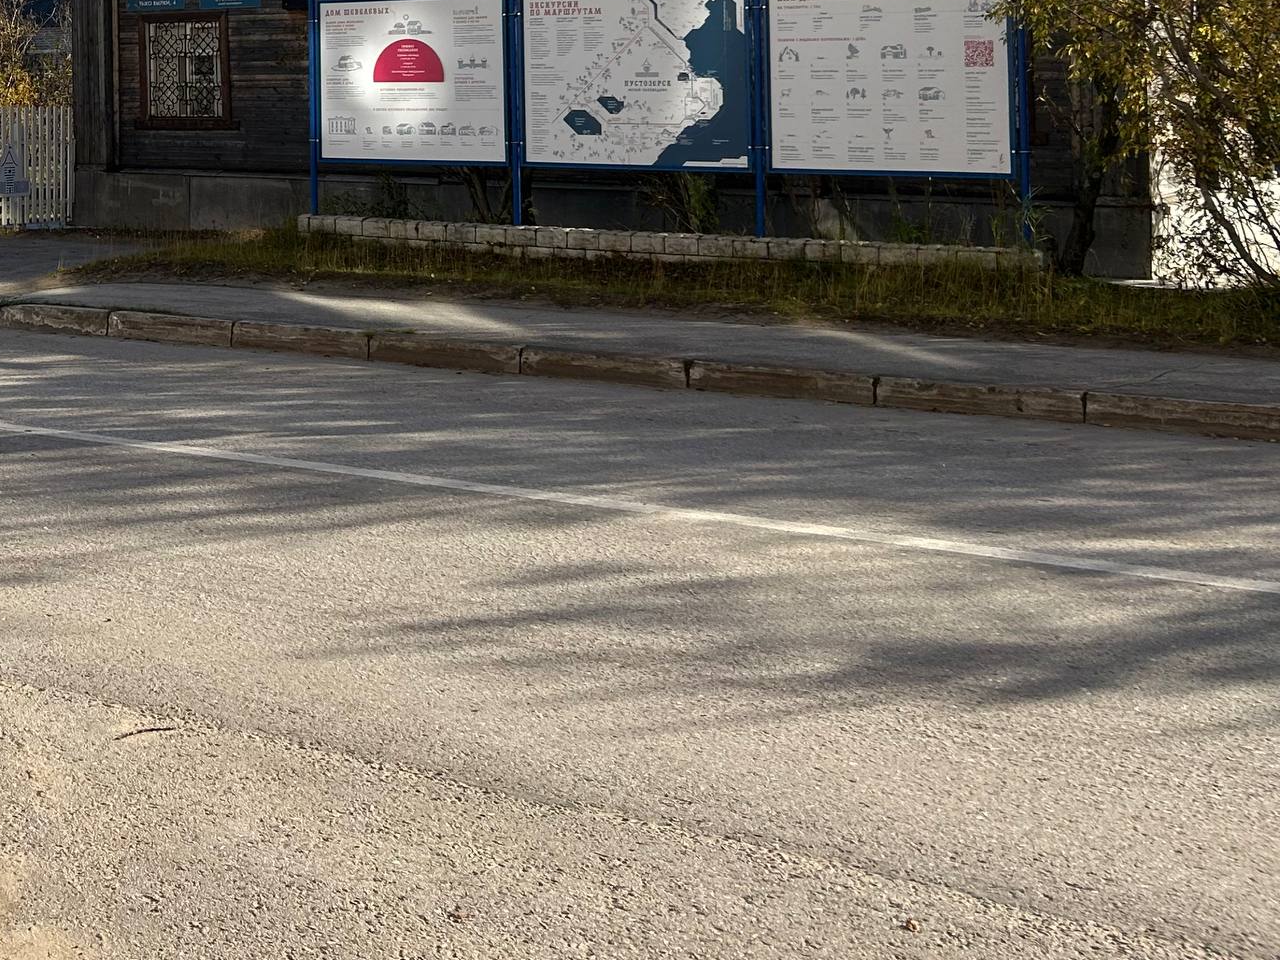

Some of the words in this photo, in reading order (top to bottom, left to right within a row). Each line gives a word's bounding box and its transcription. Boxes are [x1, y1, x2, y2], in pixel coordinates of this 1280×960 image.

[529, 0, 580, 9] ЭКСКУРСИИ
[325, 9, 341, 17] ДОМ
[343, 7, 390, 16] ШЕВЕЛЕВЫХ
[544, 7, 602, 16] МАРШРУТАМ
